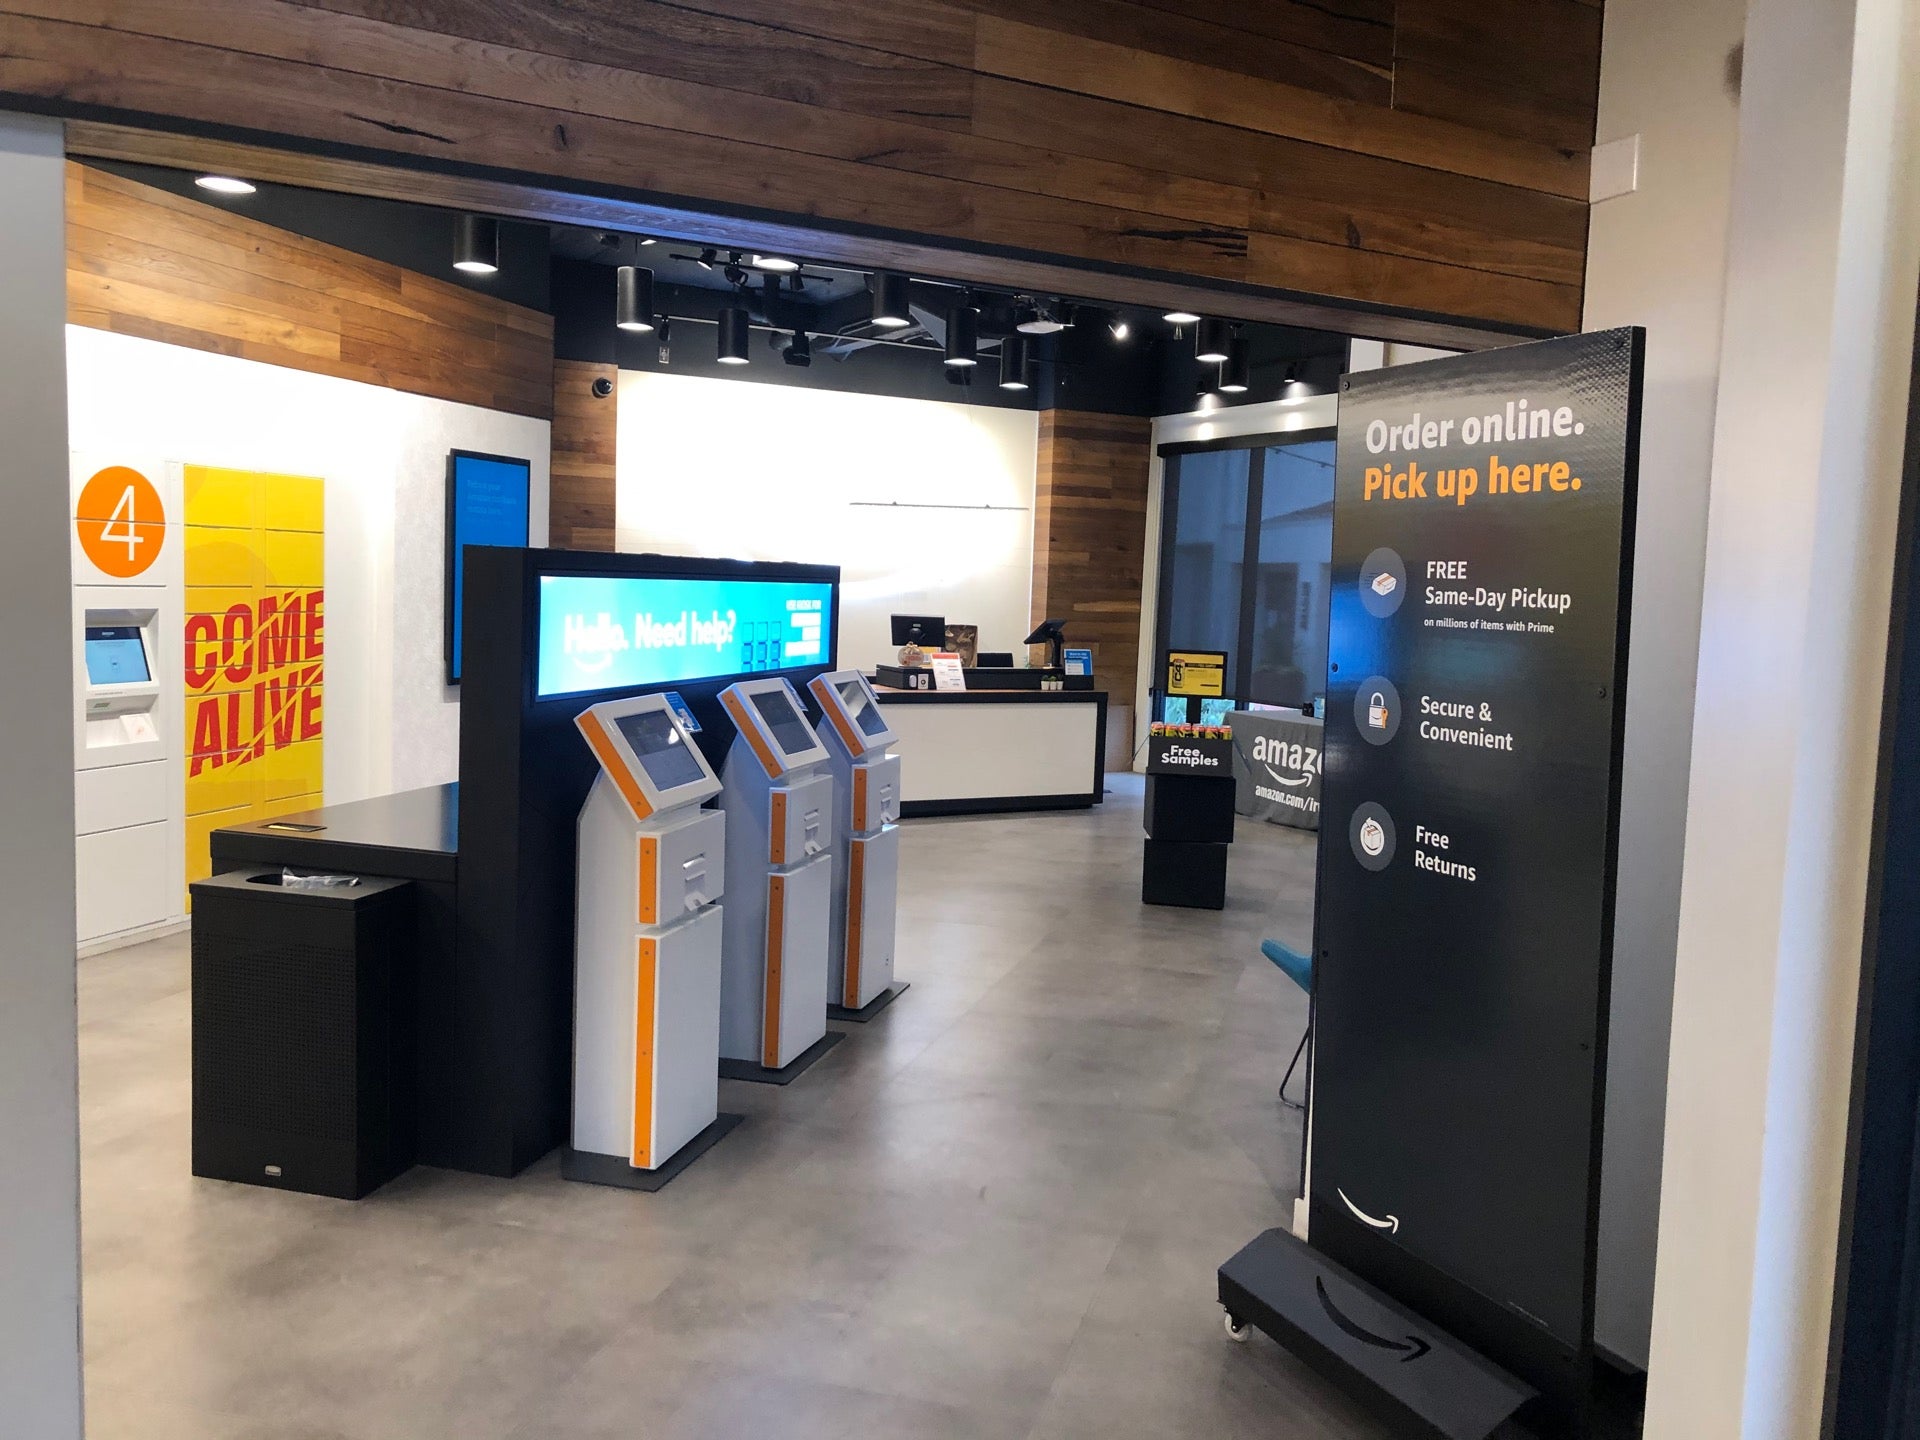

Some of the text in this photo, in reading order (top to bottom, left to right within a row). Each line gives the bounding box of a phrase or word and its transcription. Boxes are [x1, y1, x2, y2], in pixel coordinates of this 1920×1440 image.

[1365, 399, 1585, 454] Order online.
[1363, 456, 1582, 506] Pick up here.
[100, 485, 144, 561] 4
[1426, 561, 1467, 579] FREE
[1425, 586, 1571, 614] Same-Day Pickup
[635, 611, 686, 649] Need
[691, 609, 737, 653] help?
[1424, 617, 1555, 633] on millions of items with Prime
[184, 590, 324, 693] COME
[189, 664, 323, 778] ALIVE
[1420, 695, 1493, 722] Secure &
[1170, 745, 1201, 757] Free
[1420, 720, 1513, 751] Convenient
[1161, 752, 1219, 768] Samples
[1415, 825, 1450, 849] Free
[1415, 850, 1477, 881] Returns
